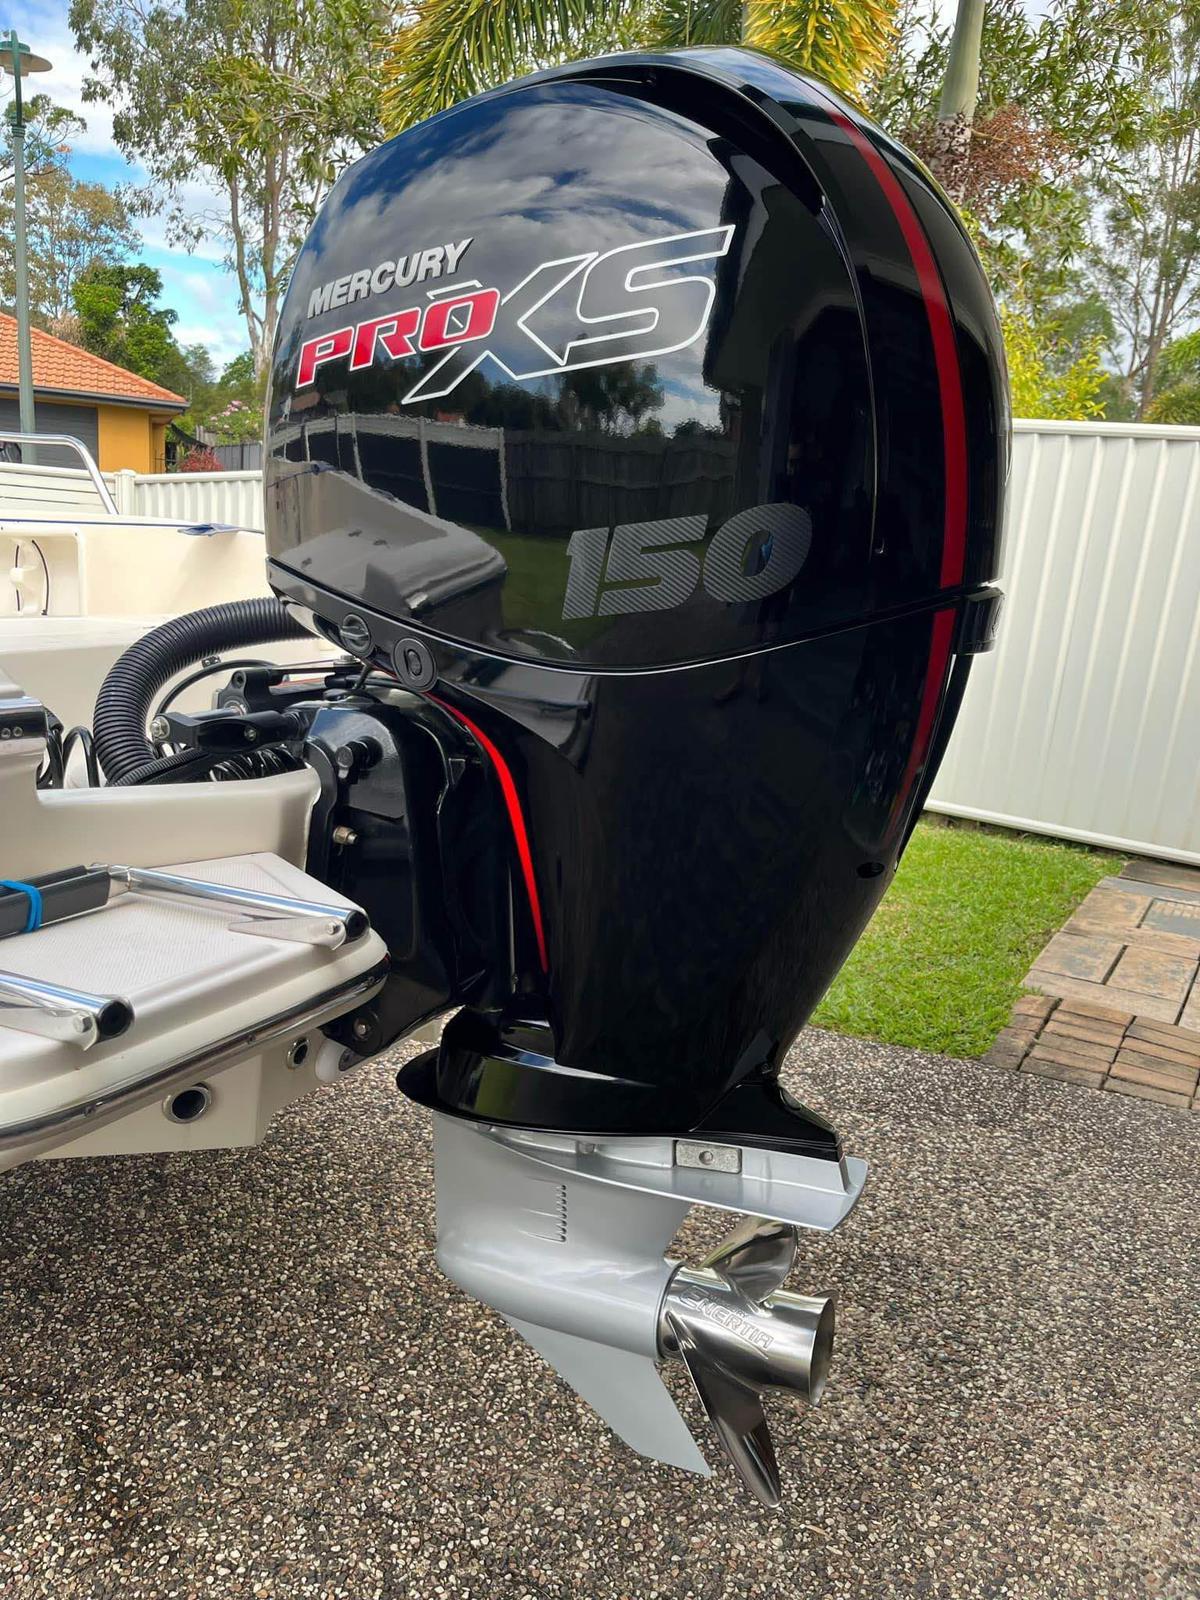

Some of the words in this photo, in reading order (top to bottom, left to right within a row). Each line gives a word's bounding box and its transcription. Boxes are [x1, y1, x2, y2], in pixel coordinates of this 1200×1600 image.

[307, 237, 474, 319] MERCURY
[561, 502, 813, 620] 150
[679, 1285, 774, 1349] ENERTIA
